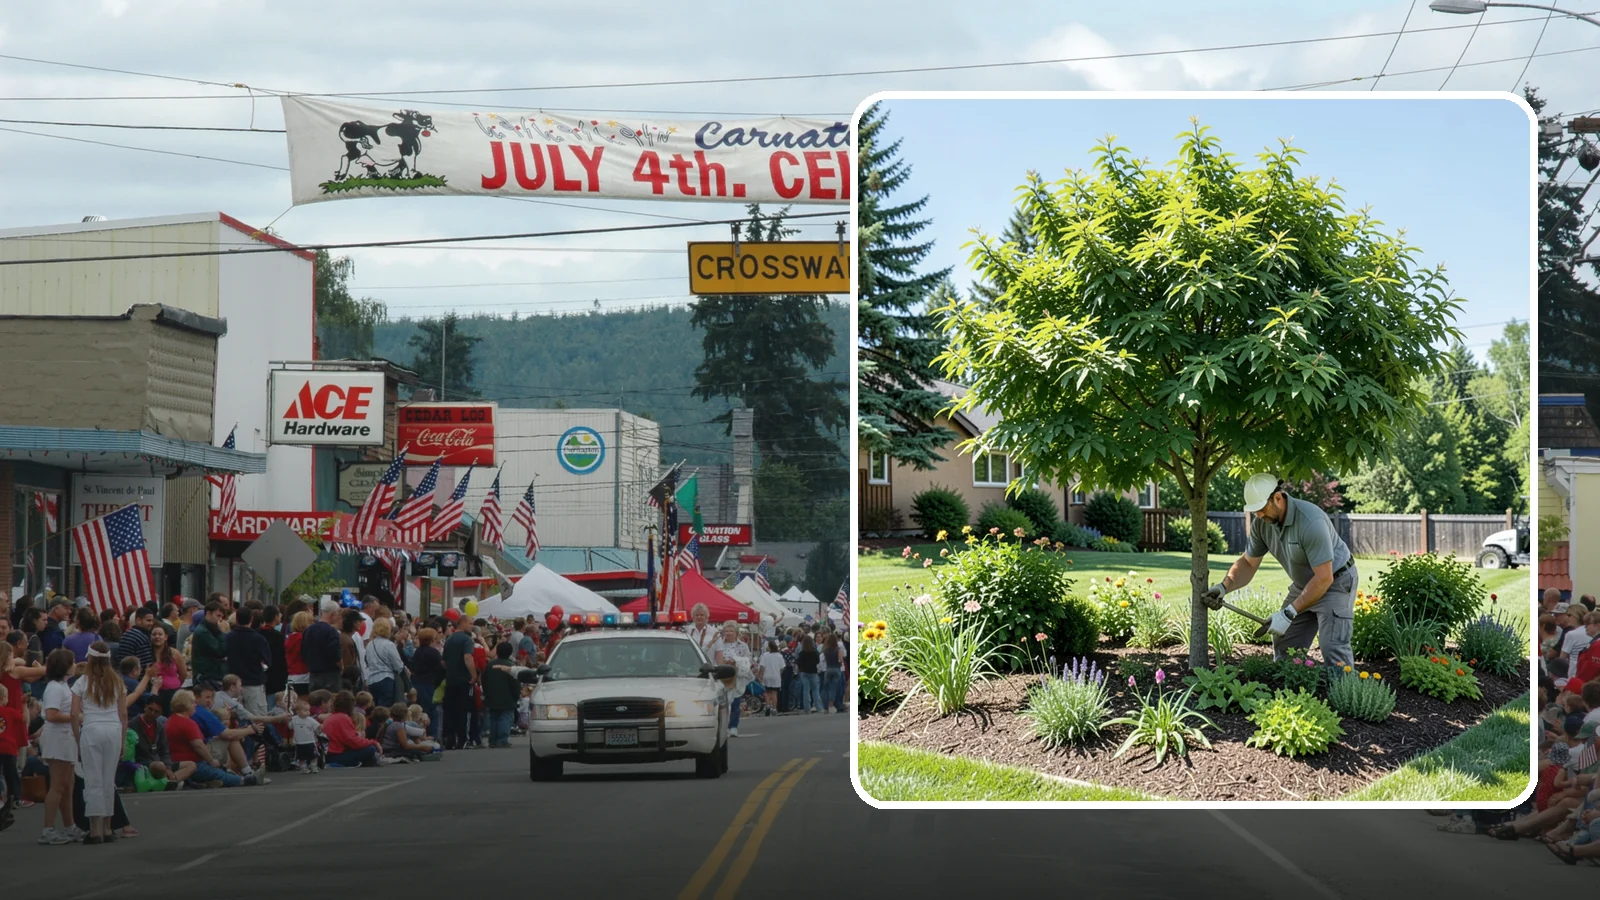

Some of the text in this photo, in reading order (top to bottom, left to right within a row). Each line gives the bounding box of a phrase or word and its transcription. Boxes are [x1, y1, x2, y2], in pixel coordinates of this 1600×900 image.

[694, 121, 850, 150] Carnat
[481, 141, 605, 193] JULY
[632, 150, 746, 197] 4th.
[697, 254, 850, 279] CROSSWA
[282, 380, 373, 420] ACE
[405, 410, 452, 421] CEDAR
[283, 421, 371, 437] Hardware
[416, 428, 477, 447] Coca-Cola
[353, 467, 385, 480] Simpl
[95, 485, 124, 494] Vincent
[126, 486, 135, 495] de
[137, 485, 155, 495] Paul
[212, 516, 331, 536] HARDARE
[688, 526, 741, 535] CRNATION
[699, 535, 730, 544] GLASS
